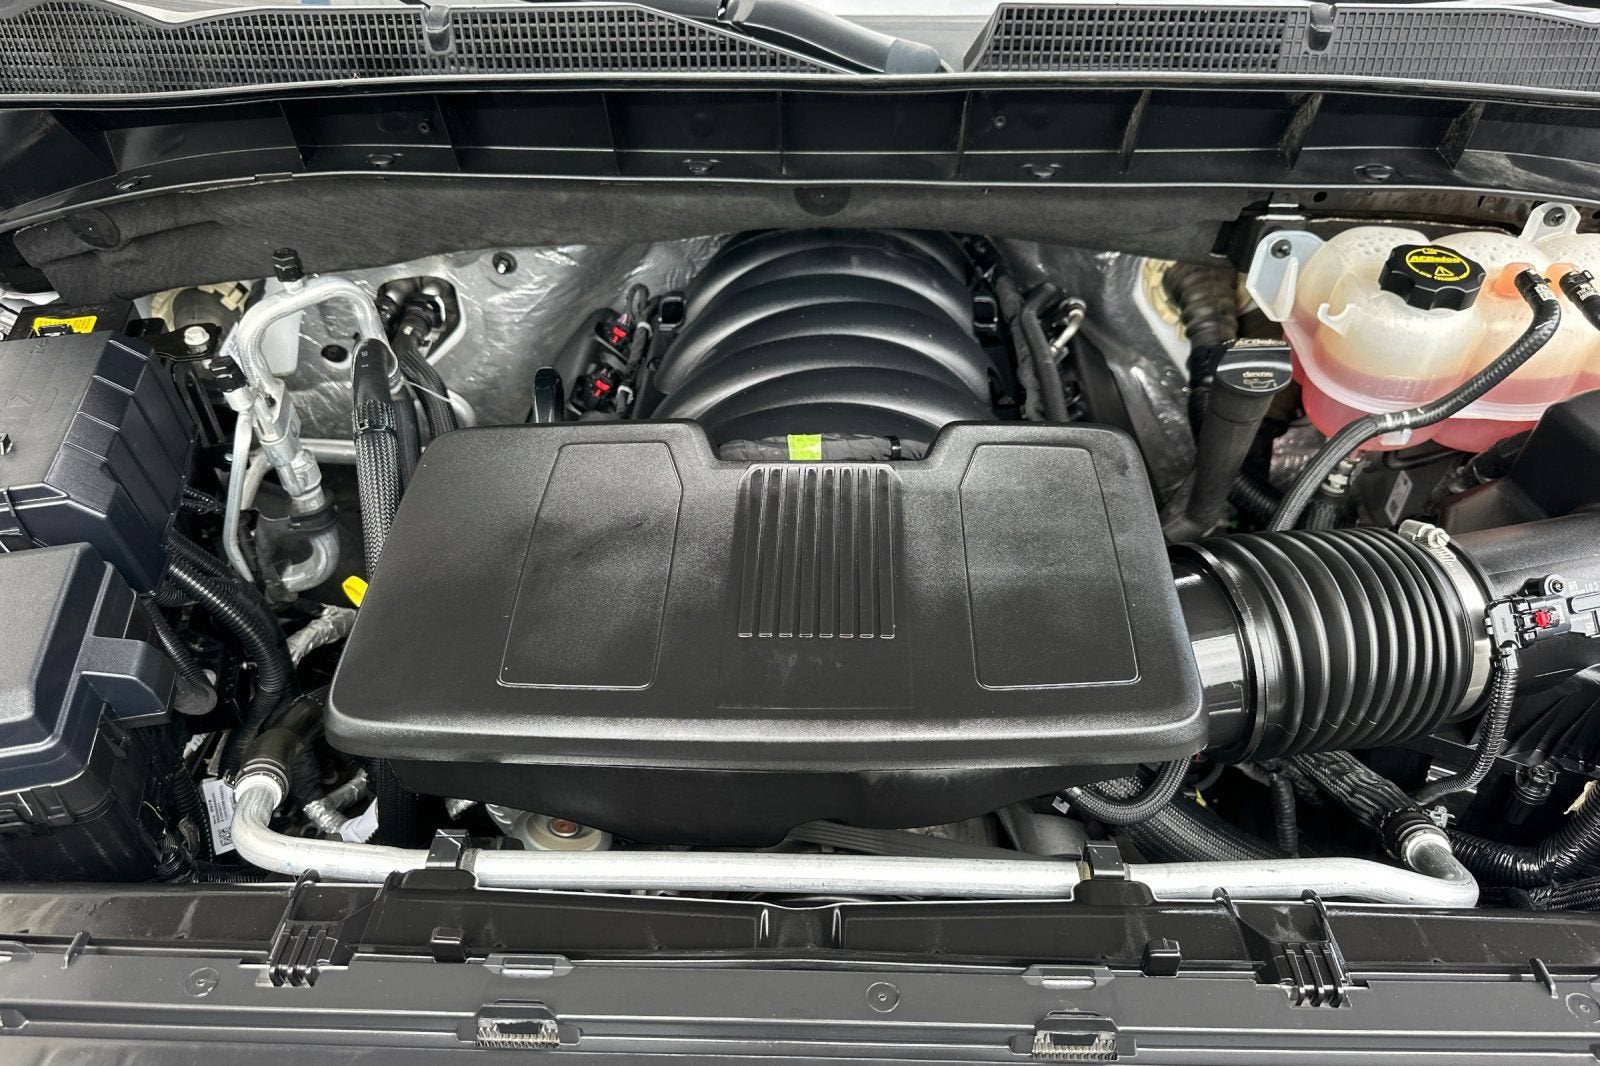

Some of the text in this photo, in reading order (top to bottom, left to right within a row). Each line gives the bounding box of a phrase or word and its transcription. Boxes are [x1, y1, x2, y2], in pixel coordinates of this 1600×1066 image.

[1409, 255, 1461, 263] ACDelco
[1233, 338, 1287, 348] ACDelco
[1242, 370, 1274, 378] dexos
